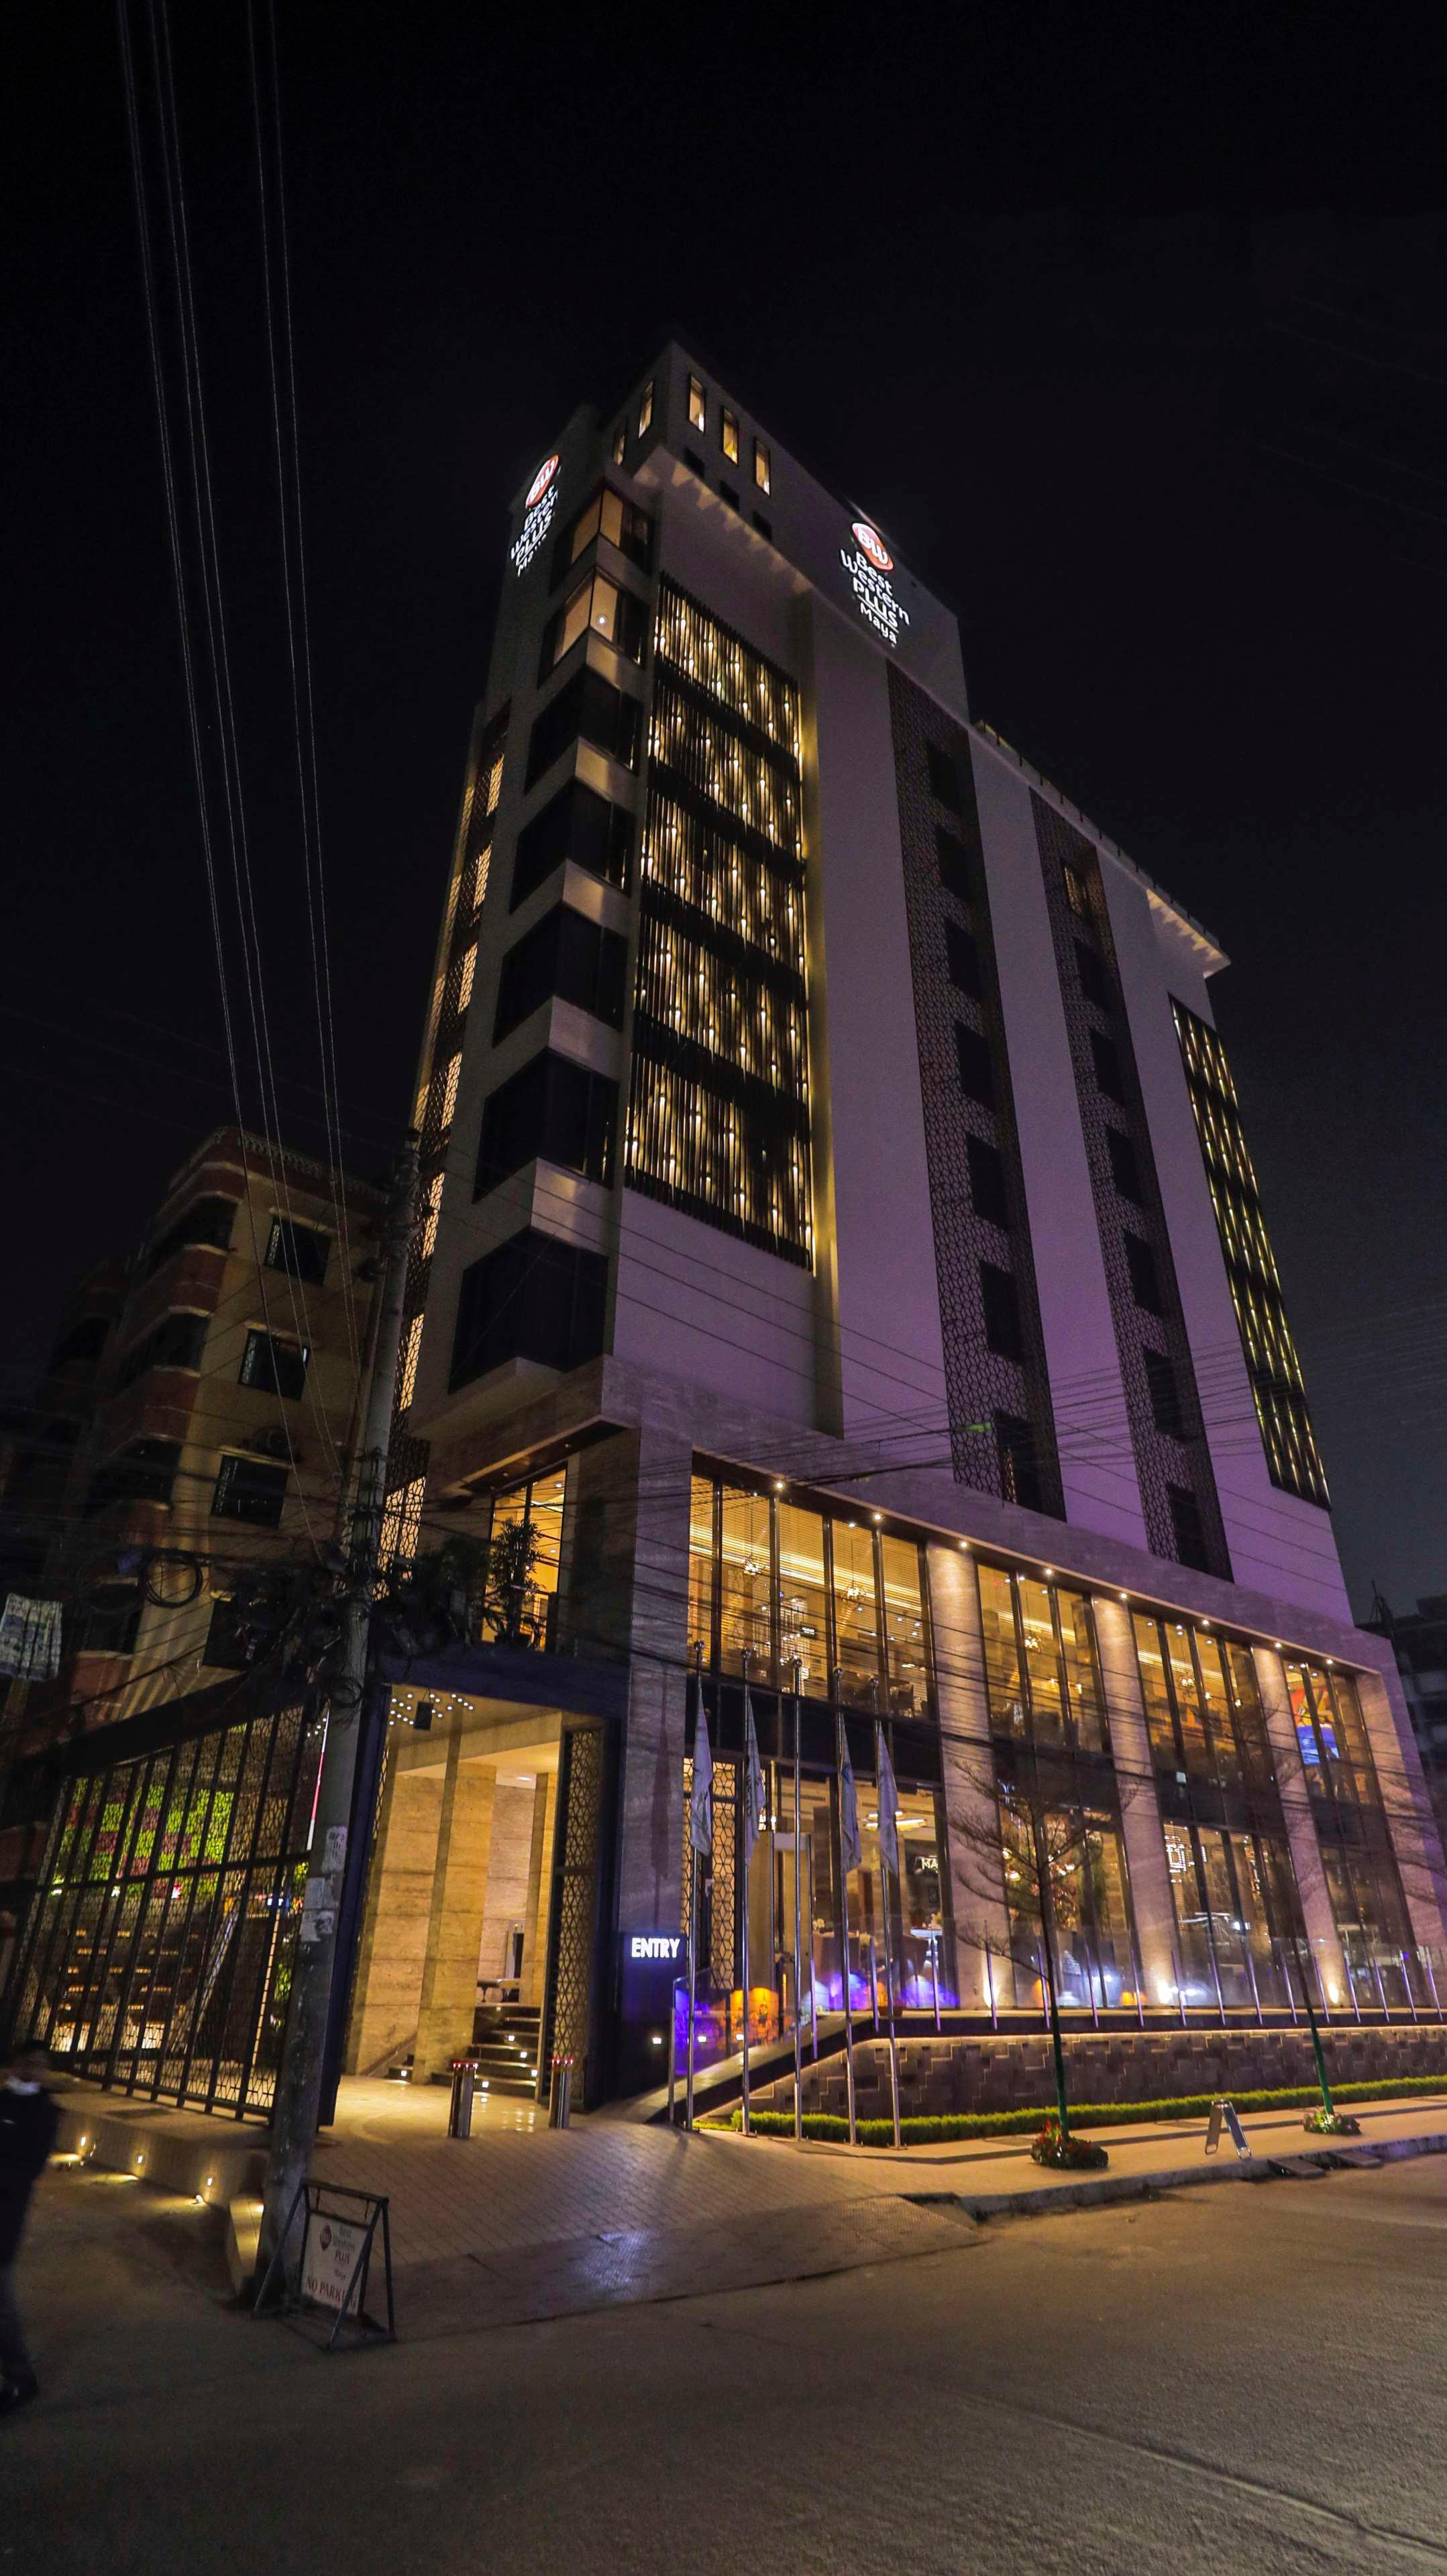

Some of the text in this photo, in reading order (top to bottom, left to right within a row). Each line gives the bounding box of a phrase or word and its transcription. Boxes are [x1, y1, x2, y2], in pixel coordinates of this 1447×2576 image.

[511, 488, 558, 560] Western
[524, 484, 555, 531] Best
[840, 549, 910, 626] Western
[856, 551, 892, 596] Best
[853, 577, 898, 627] PLUS
[860, 602, 897, 644] Maya
[631, 1937, 680, 1958] ENTRY
[306, 2275, 356, 2308] NO PARKIG
